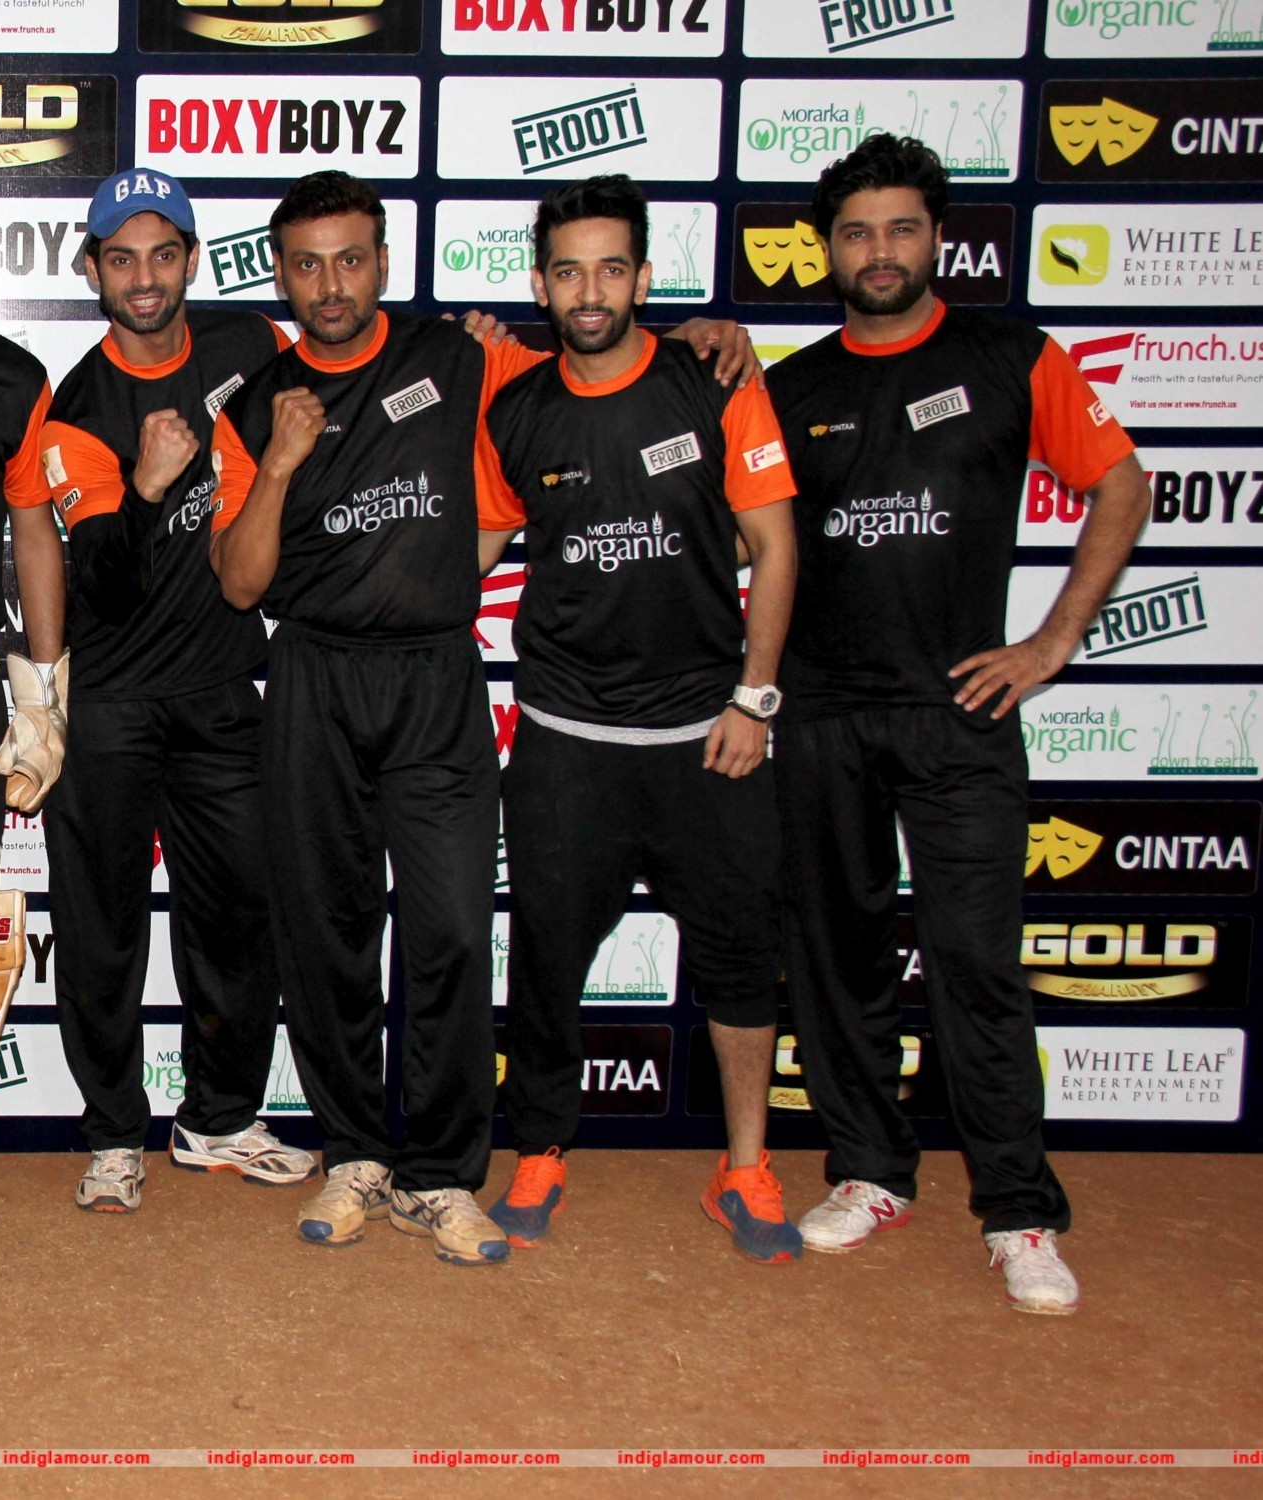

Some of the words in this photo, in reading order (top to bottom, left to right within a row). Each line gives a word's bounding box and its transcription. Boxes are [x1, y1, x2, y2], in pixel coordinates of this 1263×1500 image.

[1, 25, 55, 34] www.frunch.us
[220, 25, 337, 42] CHARITY
[781, 103, 850, 122] Morarka
[148, 99, 407, 154] BOXYBOYZ
[514, 97, 645, 166] FROOTI
[1171, 117, 1263, 155] CINT
[114, 174, 172, 203] GAP
[476, 224, 534, 243] Morark
[1125, 228, 1221, 253] WHITE
[1233, 228, 1263, 253] LE
[1123, 258, 1263, 271] ENTERTAINME
[1124, 275, 1182, 286] MEDIA
[1197, 275, 1234, 286] PVT.
[1131, 374, 1162, 383] Health
[1165, 374, 1186, 383] with
[1197, 374, 1234, 383] tasteful
[390, 387, 433, 417] FROOTI
[914, 395, 962, 423] FROOTI
[1130, 400, 1146, 409] Visit
[1148, 401, 1156, 409] us
[1158, 401, 1173, 409] now
[1174, 400, 1182, 409] at
[1184, 400, 1237, 409] www.frunch.us
[828, 422, 855, 432] CINTAA
[649, 441, 695, 469] FROOTI
[559, 471, 584, 481] CINTAA
[353, 475, 414, 504] Morarka
[850, 491, 916, 511] Morarka
[323, 493, 443, 535] Organic
[586, 517, 648, 536] Morarka
[824, 508, 951, 546] Organic
[562, 532, 683, 572] Organic
[1039, 706, 1104, 724] Morarka
[1114, 835, 1250, 870] CINTAA
[1020, 924, 1217, 966] GOLD
[1057, 982, 1165, 997] CHARITY
[1063, 1048, 1154, 1072] WHITE
[1166, 1048, 1226, 1072] LEAF
[1062, 1075, 1224, 1089] ENTERTAINMENT
[1062, 1091, 1118, 1102] MEDIA
[1133, 1091, 1168, 1102] PVT.
[1185, 1091, 1220, 1102] LTD.
